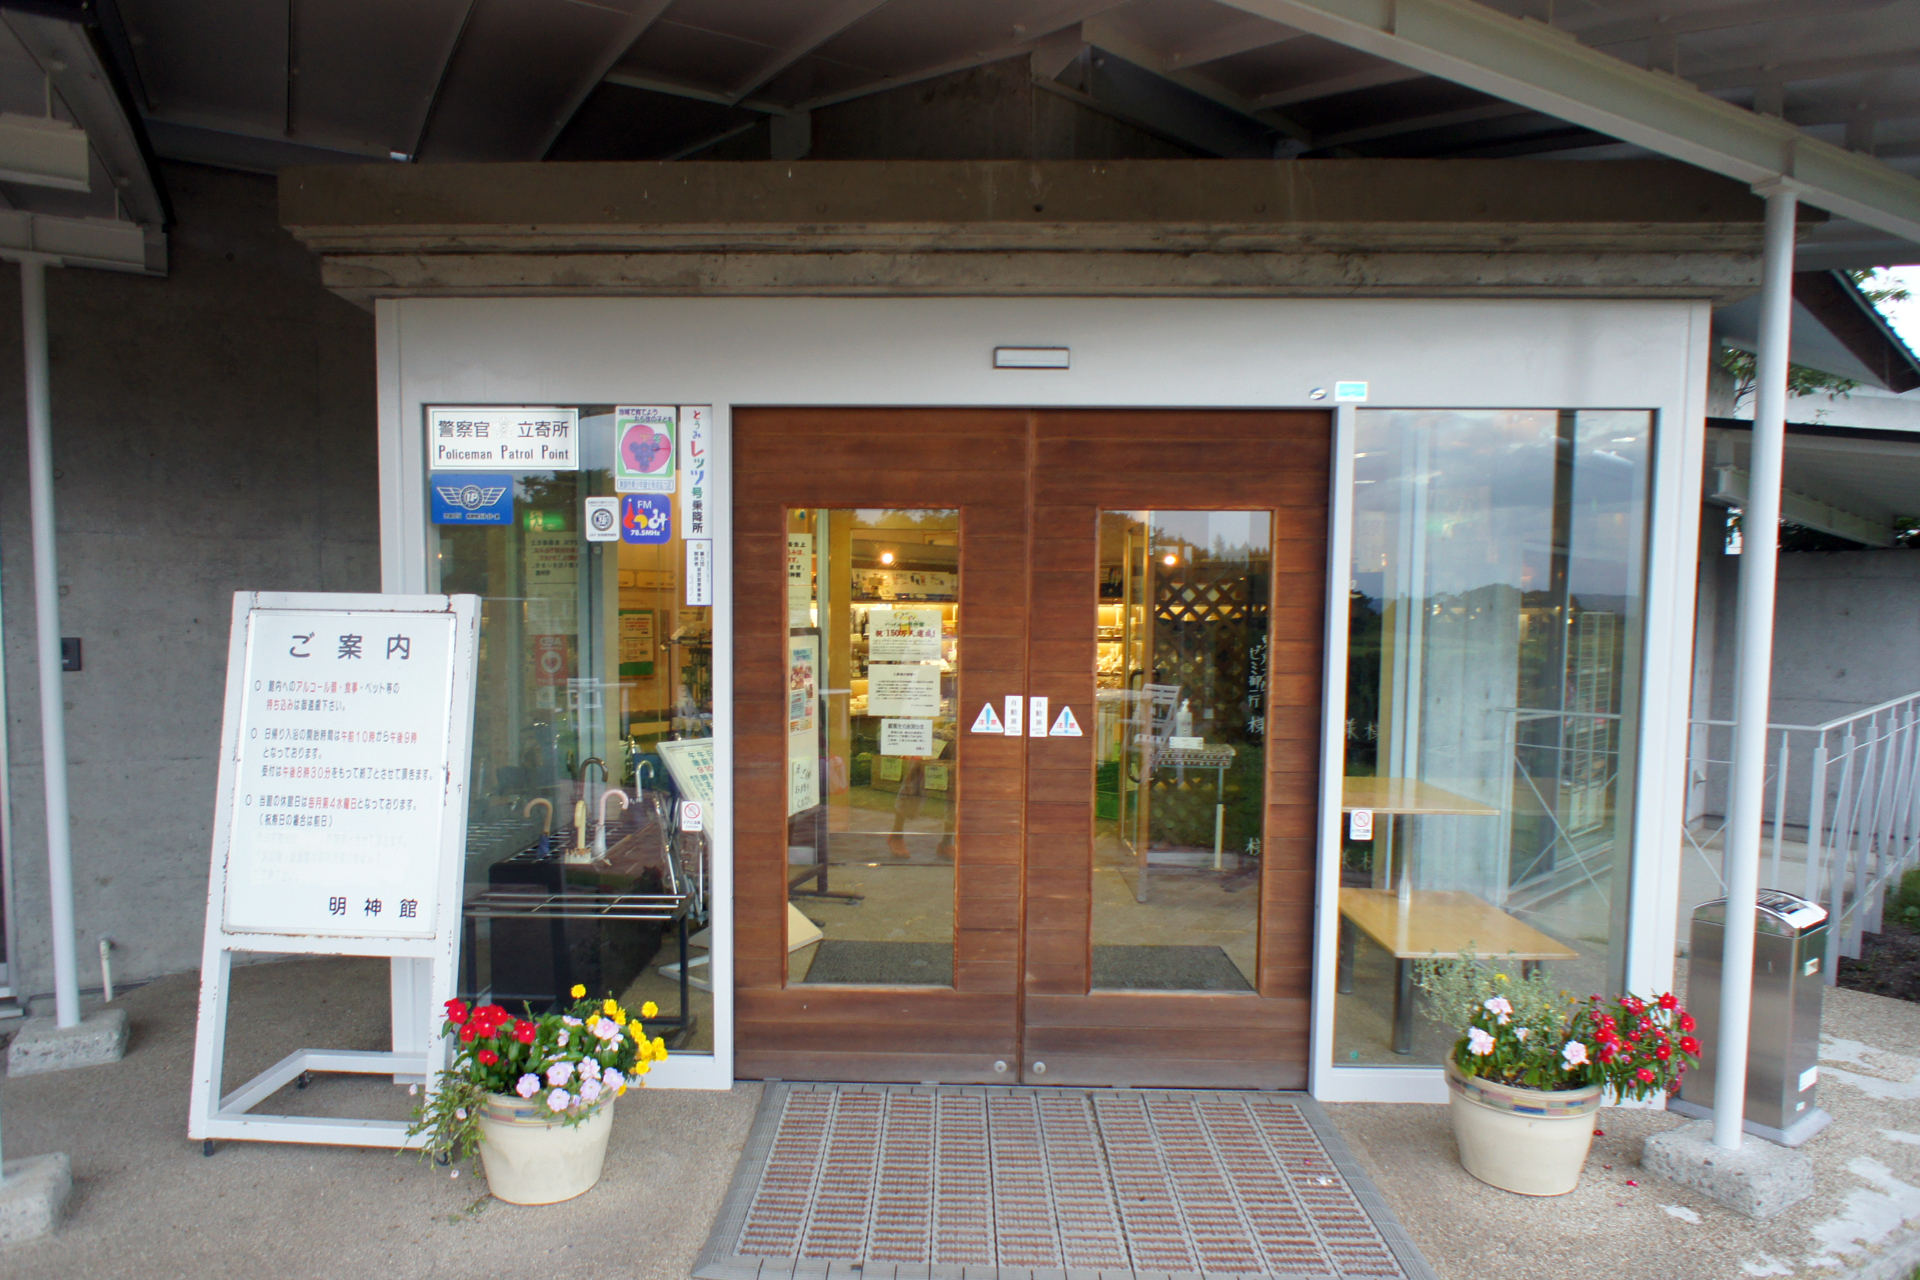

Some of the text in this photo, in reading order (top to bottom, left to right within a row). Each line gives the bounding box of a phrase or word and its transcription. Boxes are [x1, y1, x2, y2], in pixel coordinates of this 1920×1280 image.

[438, 420, 570, 438] 警察官 立寄所
[438, 445, 569, 460] Policeman Patrol Point
[638, 500, 652, 509] FM
[289, 631, 411, 660] ご案内
[263, 748, 322, 760] となっております。
[329, 896, 418, 918] 明神館
